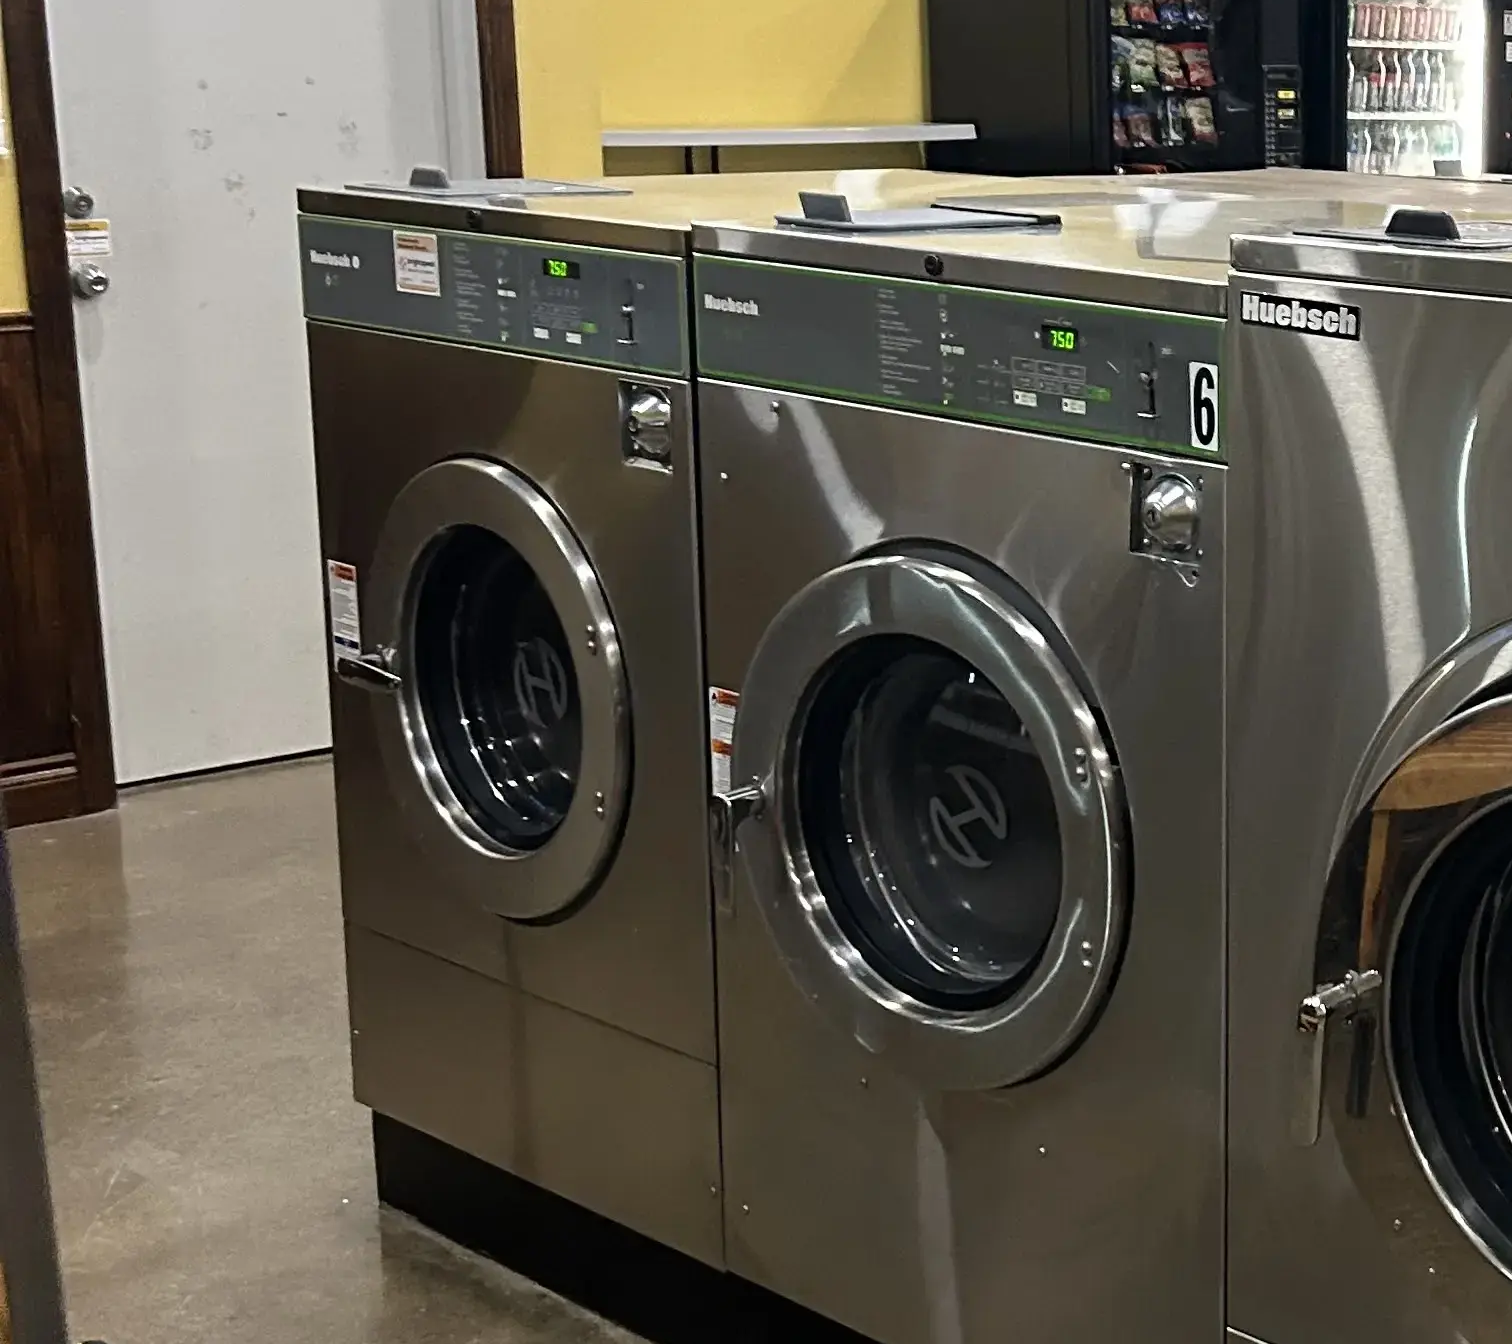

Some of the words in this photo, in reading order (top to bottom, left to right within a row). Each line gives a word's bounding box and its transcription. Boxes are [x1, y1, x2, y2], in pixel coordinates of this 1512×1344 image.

[1242, 294, 1357, 335] Huebsch
[1050, 331, 1075, 350] 750
[1194, 367, 1215, 446] 6
